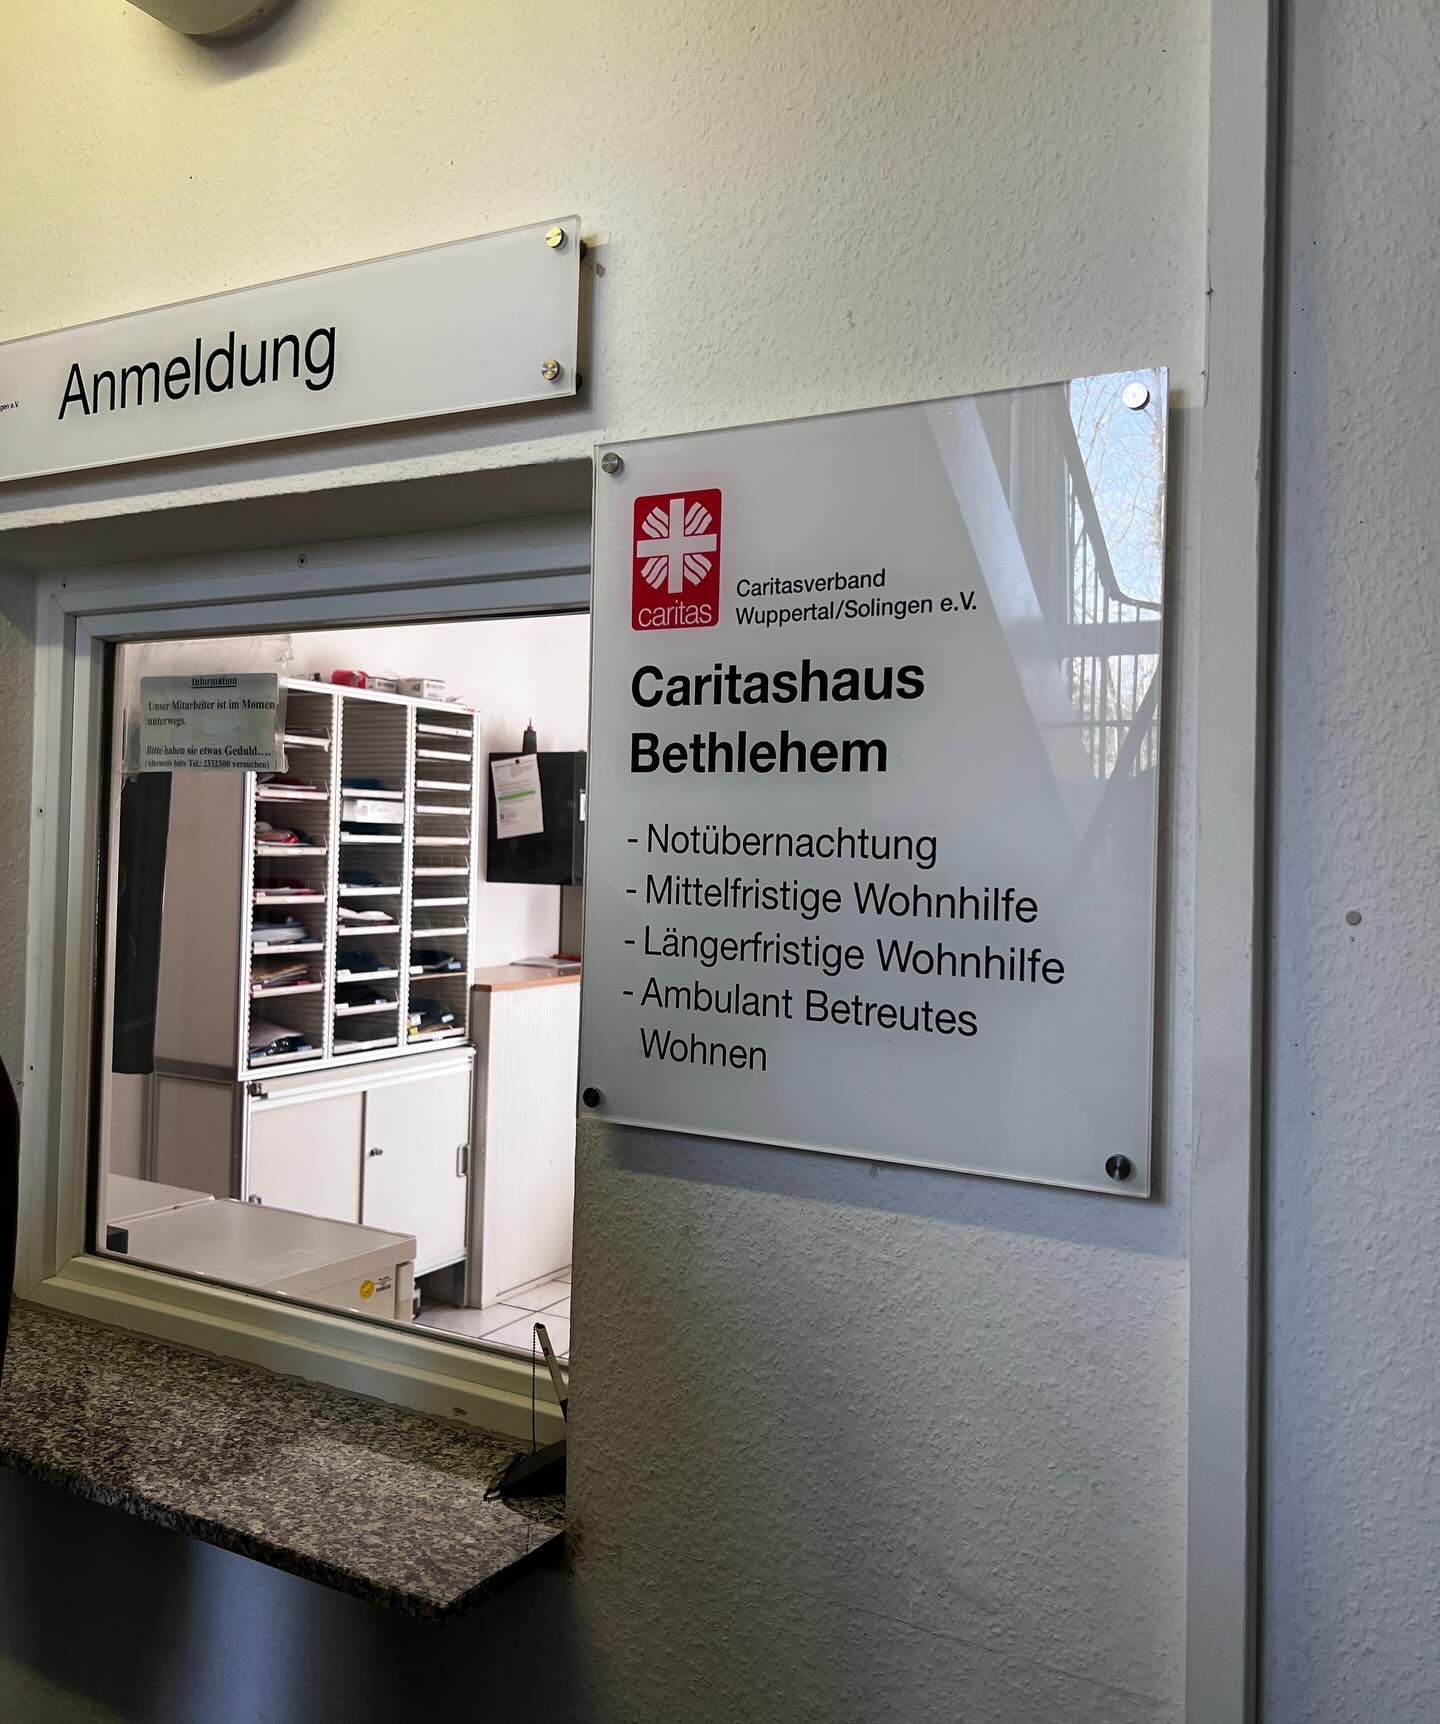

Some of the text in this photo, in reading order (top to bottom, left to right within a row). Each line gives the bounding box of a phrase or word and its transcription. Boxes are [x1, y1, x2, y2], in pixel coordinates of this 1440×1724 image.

[58, 327, 336, 420] Anmeldung
[736, 568, 886, 597] Caritasverband
[638, 600, 712, 627] caritas
[735, 591, 977, 628] Wuppertal/Solingen e.V.
[191, 676, 238, 688] Information
[631, 659, 925, 708] Caritashaus
[147, 717, 186, 727] unterwegs.
[148, 701, 170, 711] Unser
[172, 700, 215, 710] Mitarbeiter
[217, 700, 226, 710] ist
[228, 699, 239, 709] im
[146, 745, 164, 755] Bitte
[164, 745, 185, 755] haben
[187, 745, 197, 755] sie
[199, 747, 222, 755] etwas
[631, 730, 887, 774] Bethlehem
[647, 824, 937, 870] Notübernachtung
[646, 874, 842, 921] Mittelfristige
[854, 882, 1038, 923] Wohnhilfe
[644, 926, 865, 977] Längerfristige
[876, 939, 1065, 984] Wohnhilfe
[641, 977, 793, 1020] Ambulant
[805, 989, 978, 1037] Betreutes
[640, 1028, 767, 1072] Wohnen
